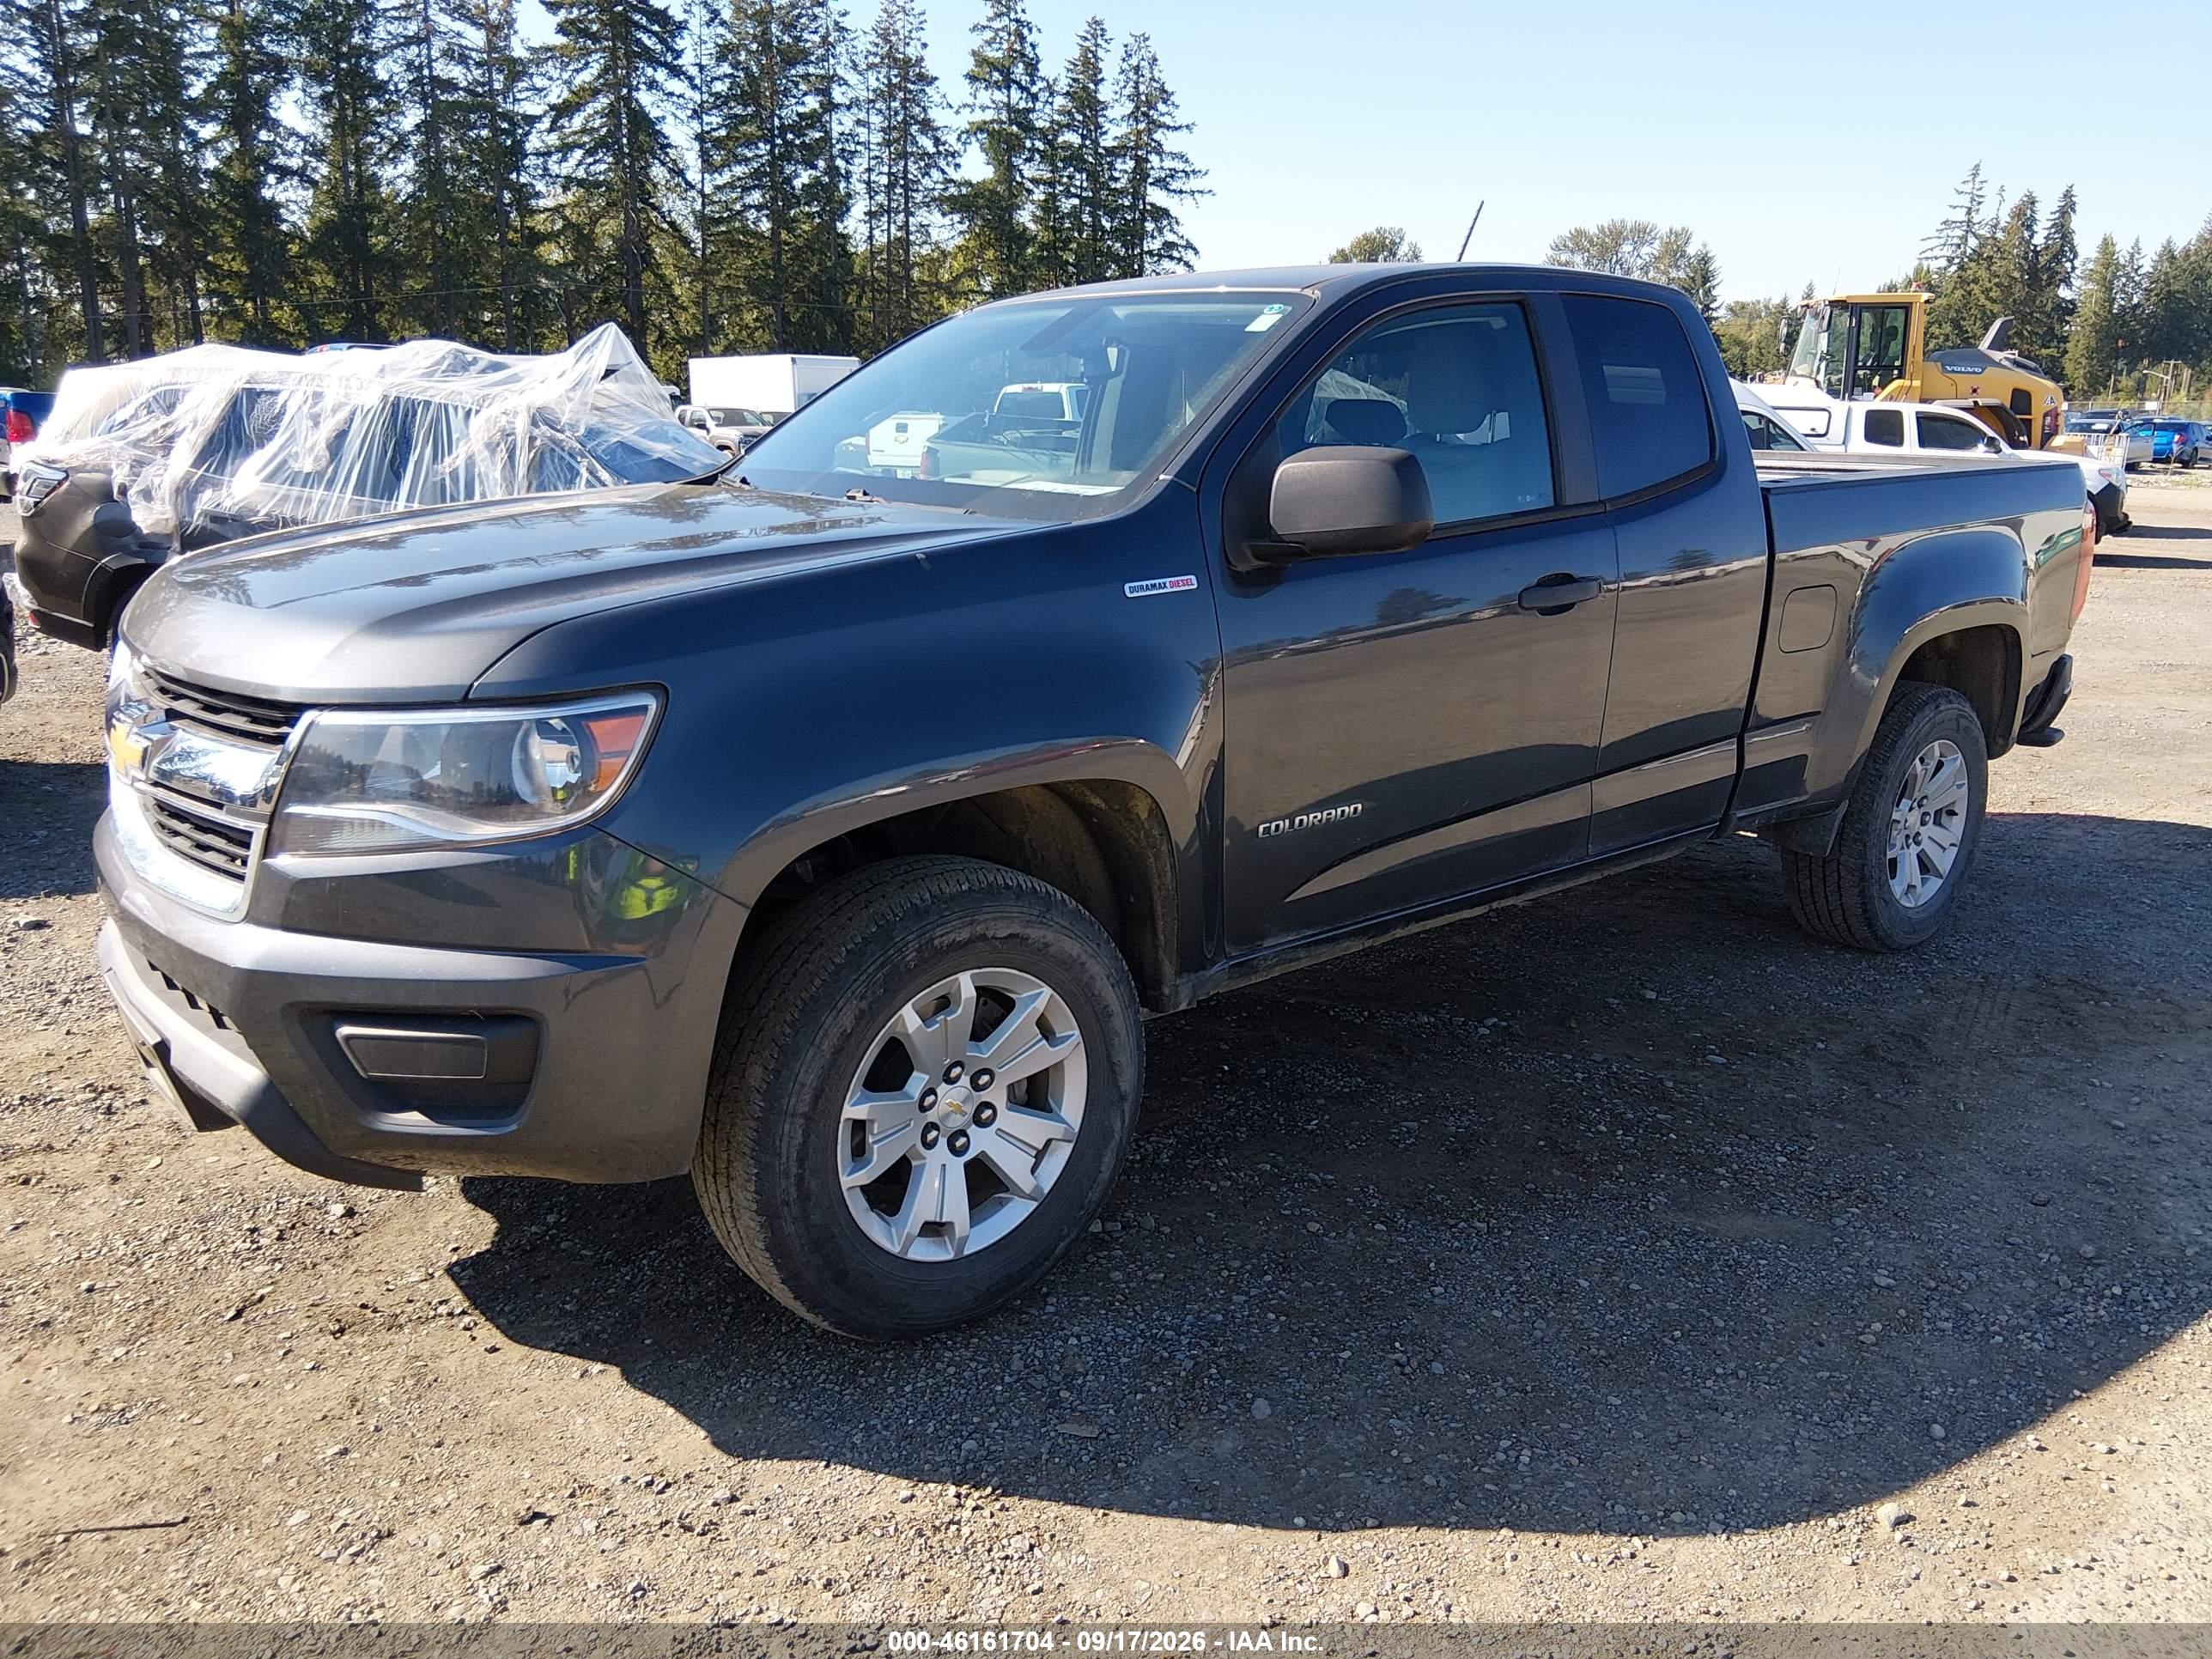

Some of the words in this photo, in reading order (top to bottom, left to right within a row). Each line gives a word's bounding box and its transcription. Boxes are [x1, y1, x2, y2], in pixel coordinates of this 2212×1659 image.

[1128, 581, 1168, 594] DURAMAX
[1169, 578, 1194, 589] DIESEL
[1258, 803, 1363, 838] COLORADO
